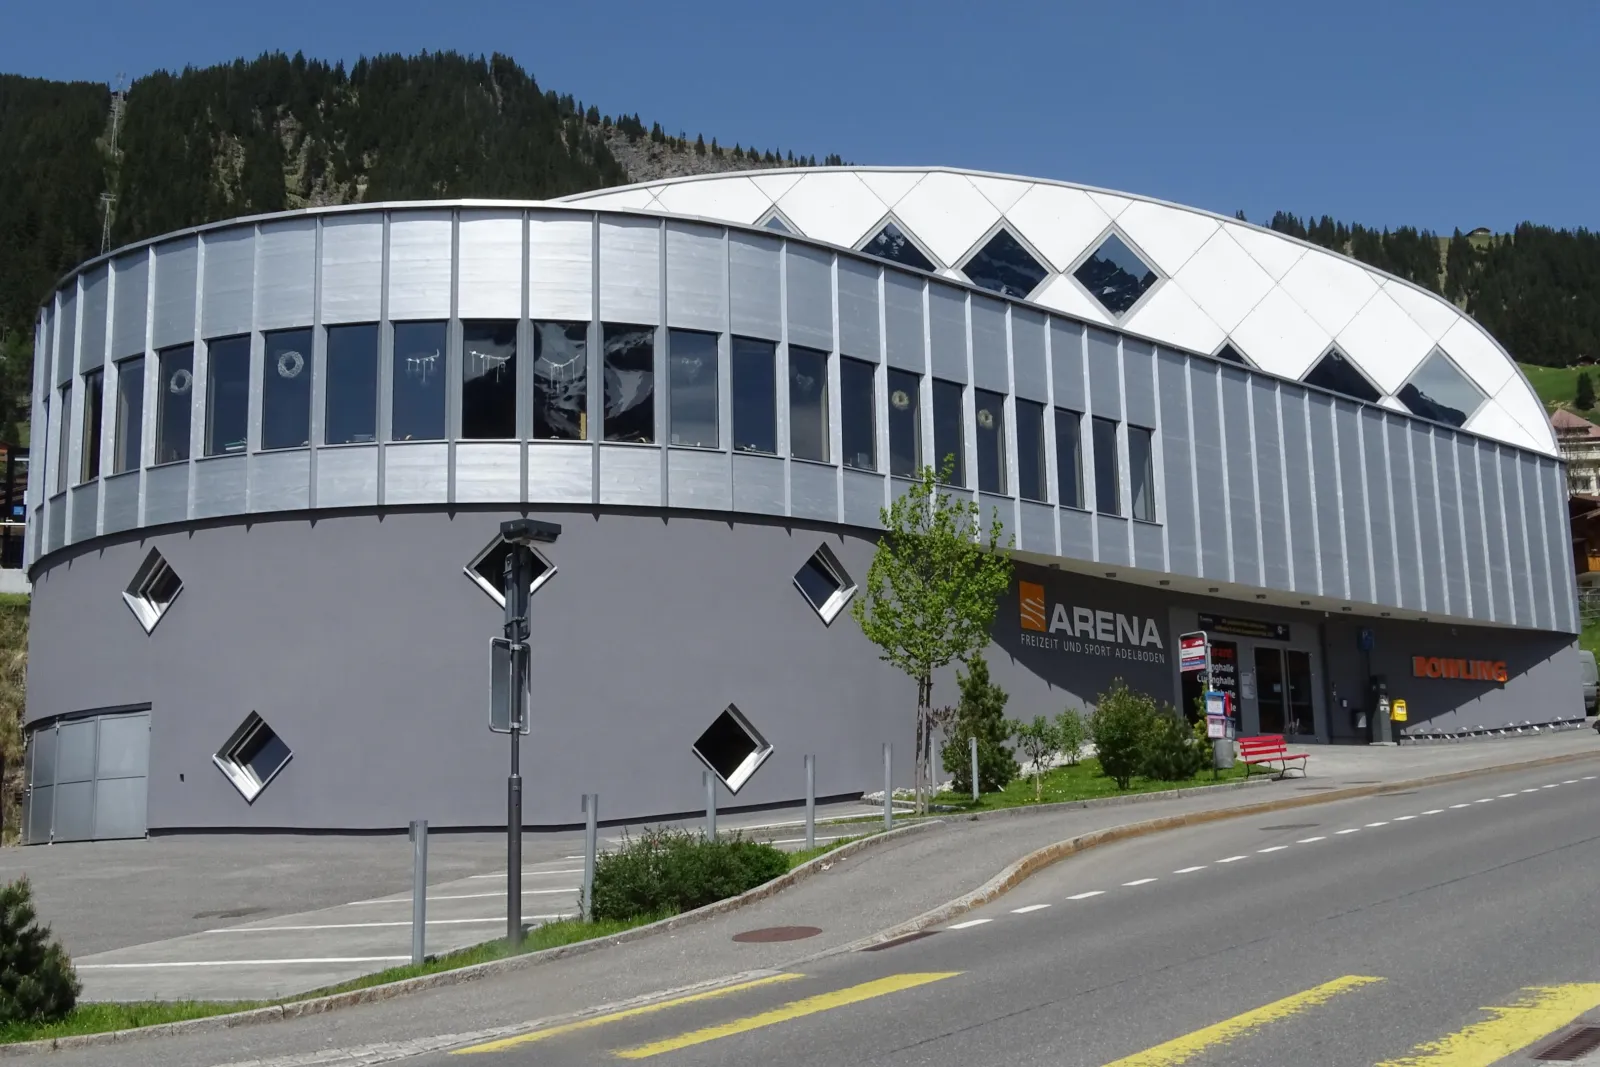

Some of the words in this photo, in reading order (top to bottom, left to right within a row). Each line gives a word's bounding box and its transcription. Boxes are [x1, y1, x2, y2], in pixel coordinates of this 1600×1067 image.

[1049, 603, 1163, 649] ARENA
[1021, 633, 1058, 648] FREIZEIT
[1063, 640, 1082, 653] UND
[1085, 643, 1111, 657] SPORT
[1115, 647, 1165, 664] ADELBODEN
[1412, 656, 1507, 682] BOWLING
